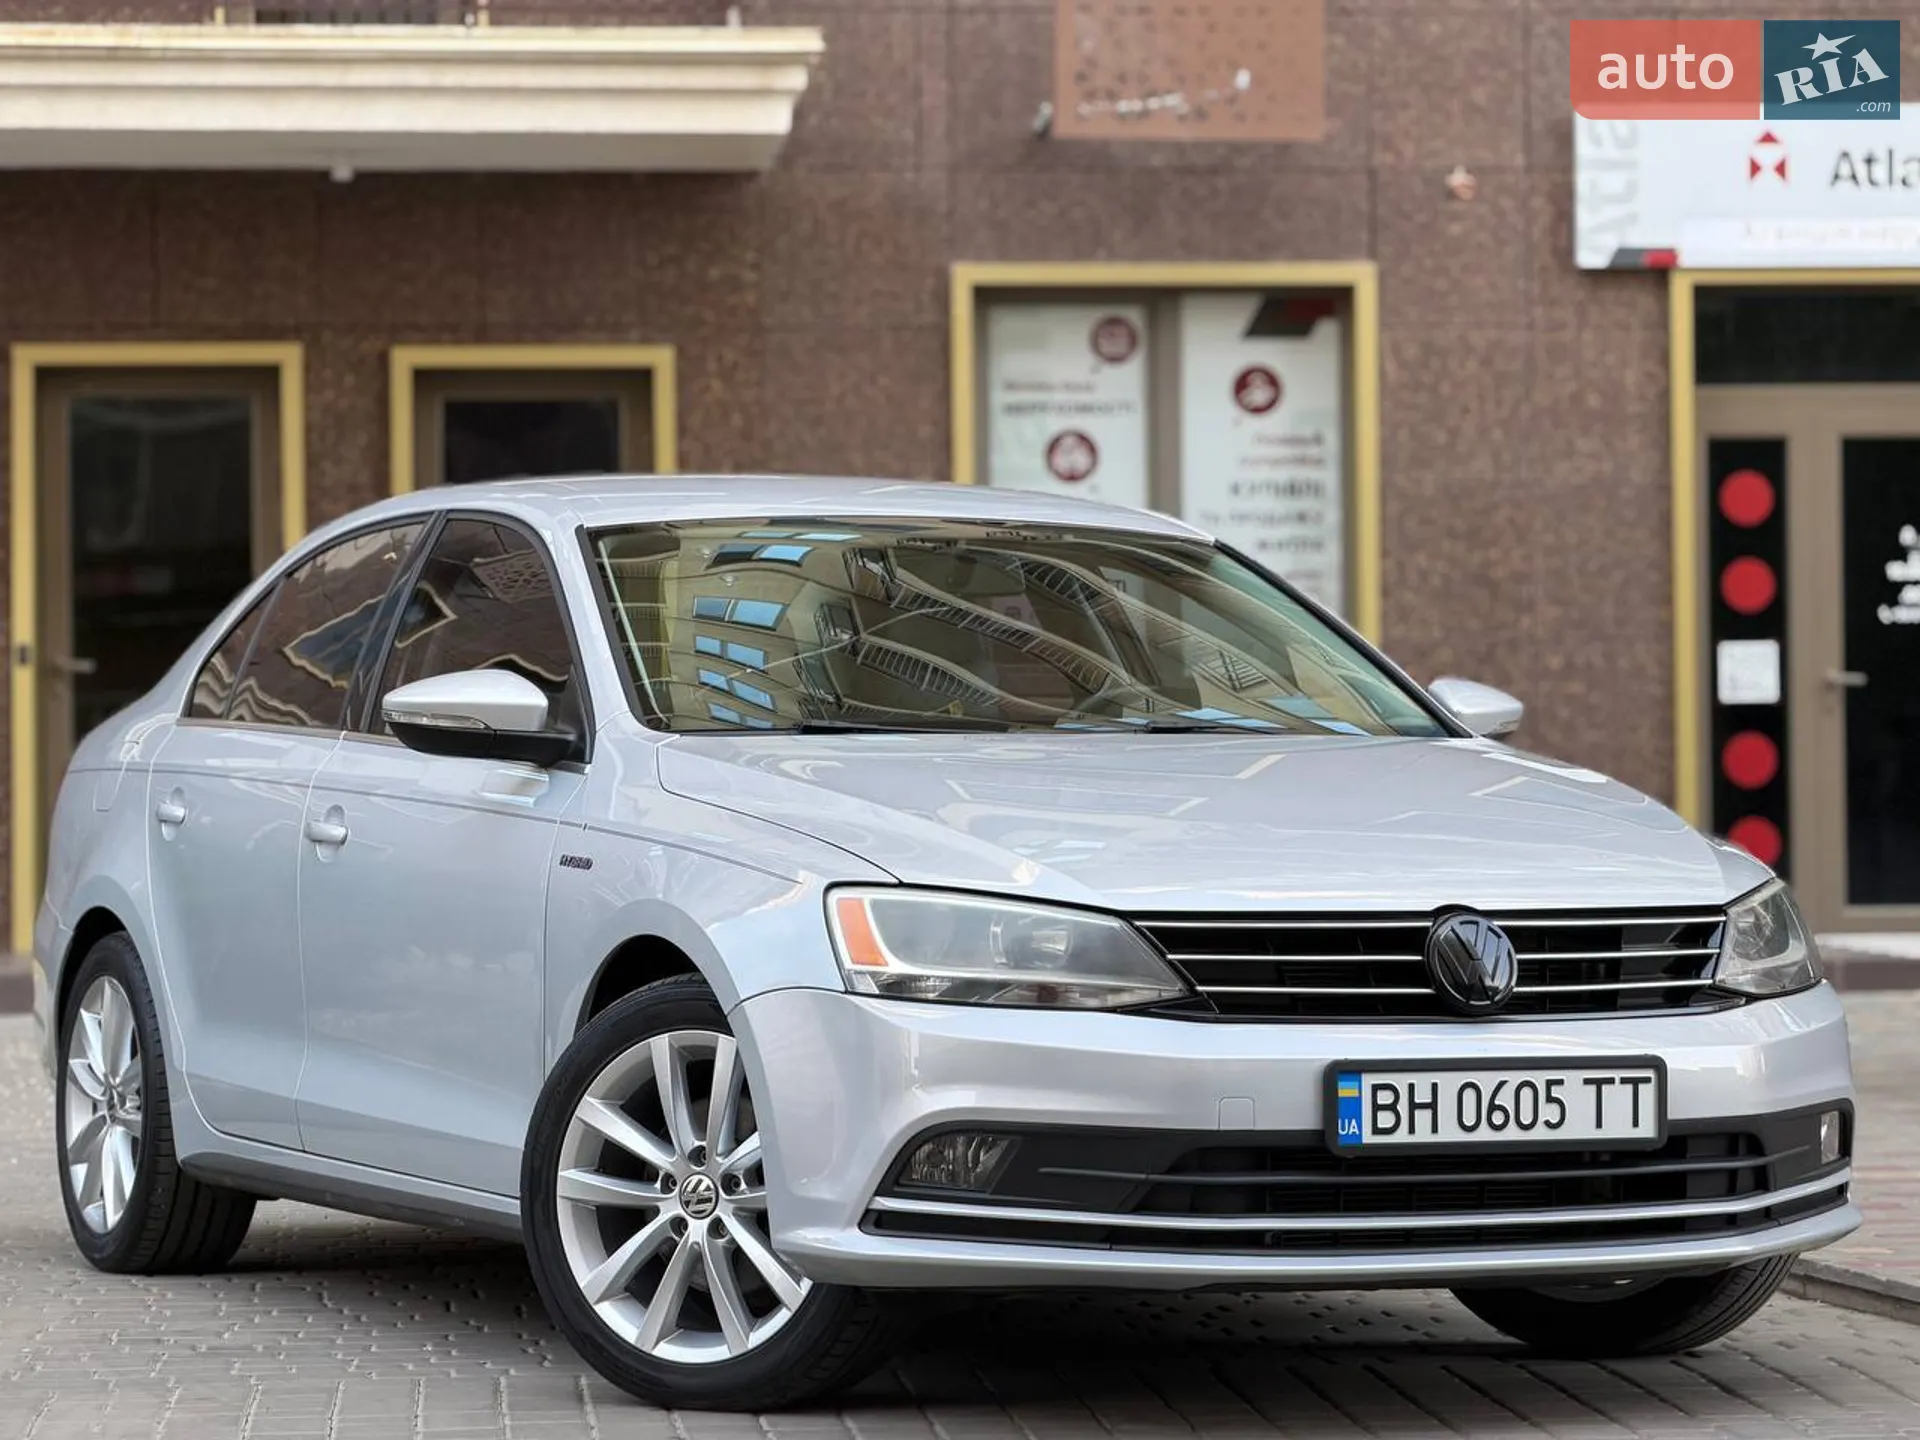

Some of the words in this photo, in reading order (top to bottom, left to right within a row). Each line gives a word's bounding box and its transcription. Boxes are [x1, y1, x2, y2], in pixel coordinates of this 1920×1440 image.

[1371, 1082, 1439, 1136] BH
[1456, 1078, 1567, 1133] 0605
[1582, 1076, 1653, 1130] TT
[1338, 1119, 1359, 1136] UA
